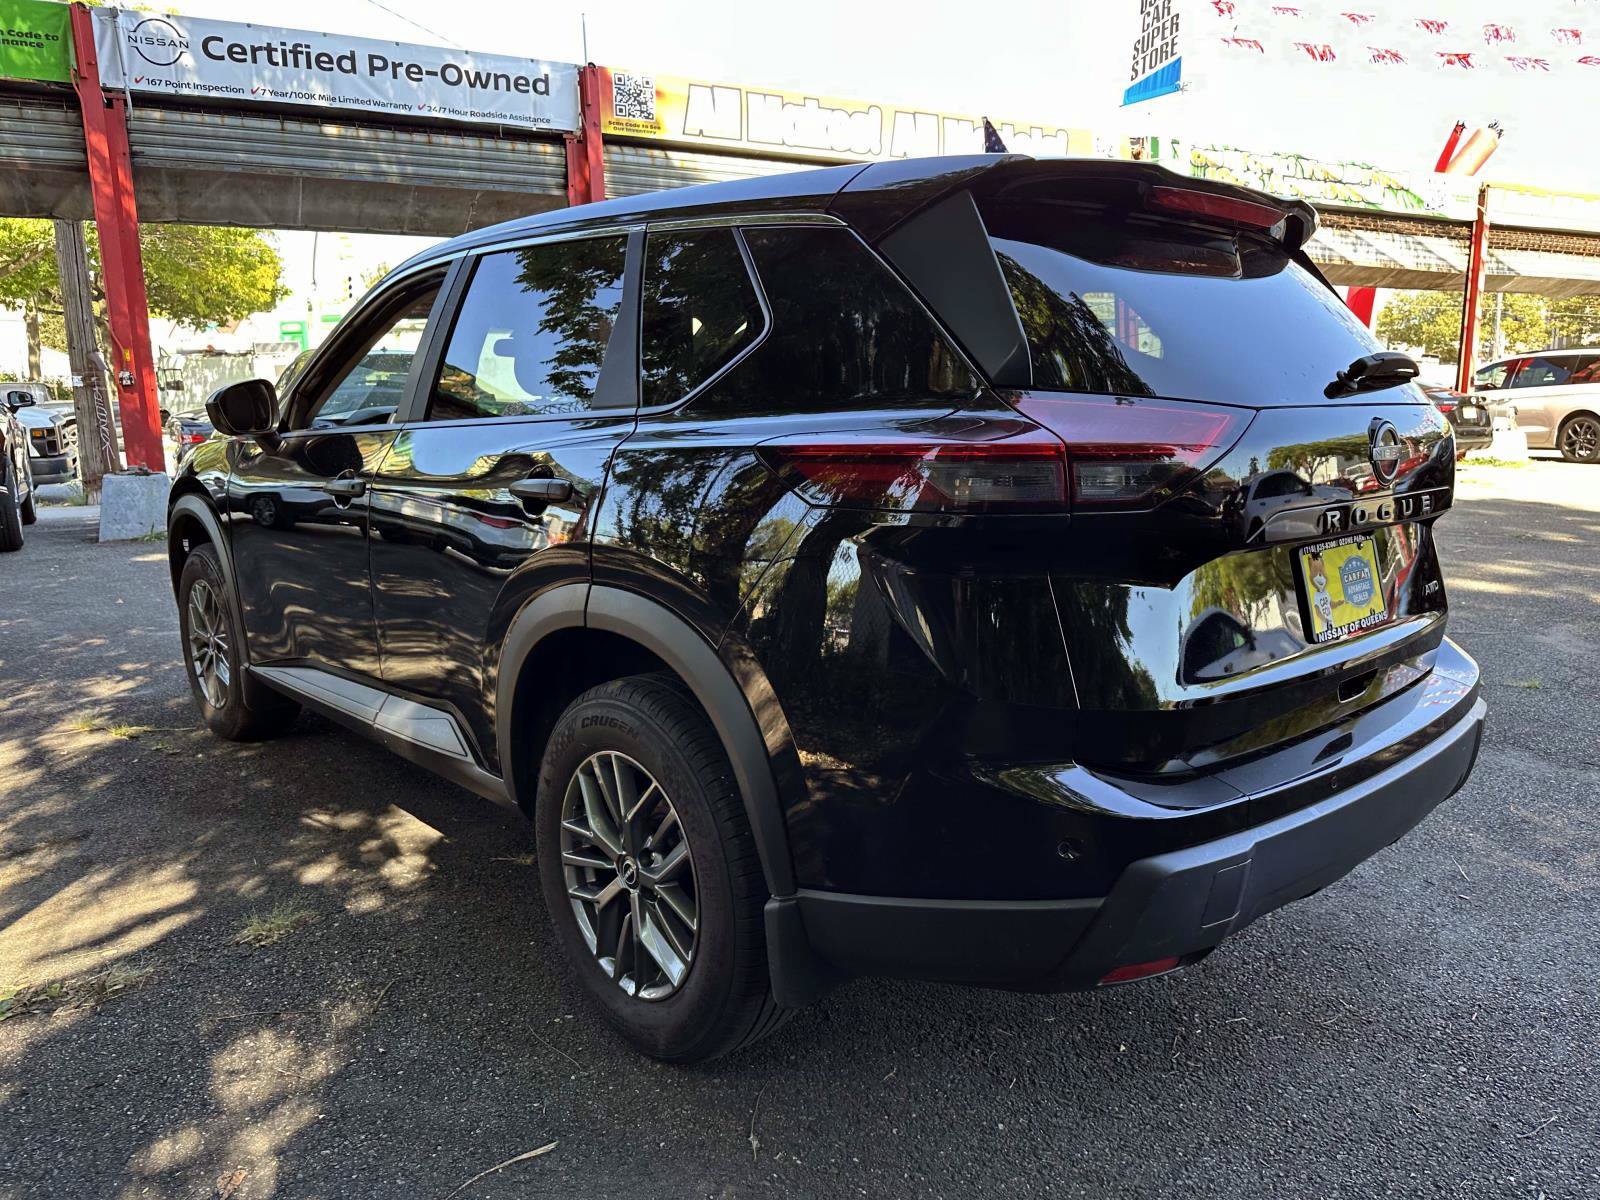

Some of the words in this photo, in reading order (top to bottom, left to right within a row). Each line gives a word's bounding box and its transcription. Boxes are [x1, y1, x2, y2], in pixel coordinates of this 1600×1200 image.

[1142, 0, 1171, 33] CAR
[7, 29, 42, 40] Code
[44, 33, 59, 41] to
[127, 35, 189, 49] NISSAN
[1133, 13, 1180, 61] SUPER
[201, 35, 357, 75] Certified
[367, 53, 550, 97] Pre-Owned
[1130, 35, 1179, 82] STORE
[145, 77, 163, 87] 167
[164, 79, 192, 90] Point
[193, 81, 245, 95] Inspection
[260, 88, 267, 96] 7
[268, 89, 317, 101] Year/100K
[318, 93, 337, 103] Mile
[338, 96, 372, 106] Limited
[372, 99, 413, 112] Warranty
[426, 105, 447, 114] 24/7
[448, 107, 469, 117] Hour
[469, 110, 508, 120] Roadside
[508, 114, 551, 124] Assistance
[1325, 495, 1431, 529] ROGUE
[1426, 580, 1439, 596] AWD
[1318, 625, 1350, 642] NISSAN
[1350, 621, 1360, 632] OF
[1360, 610, 1388, 629] QUEENS
[581, 714, 639, 740] CRUGEN
